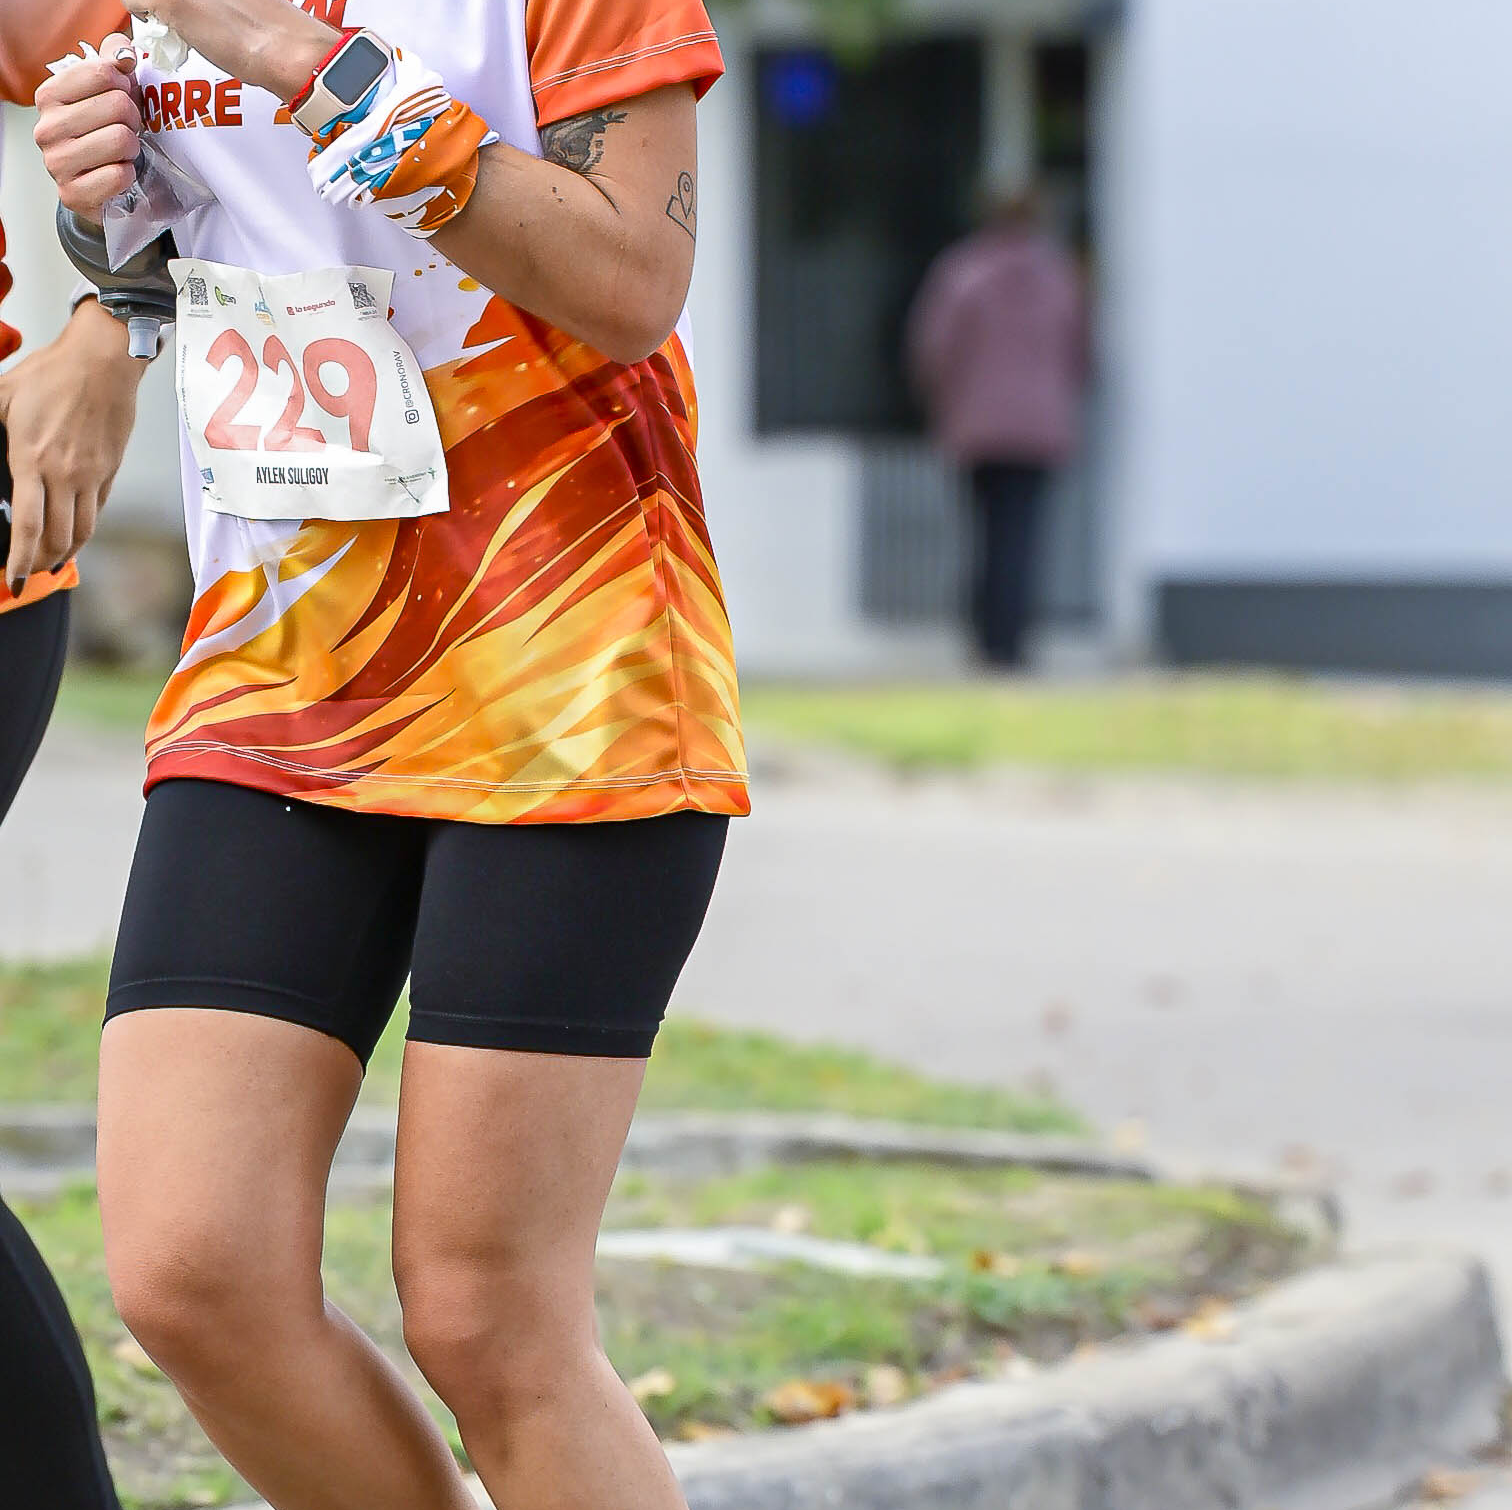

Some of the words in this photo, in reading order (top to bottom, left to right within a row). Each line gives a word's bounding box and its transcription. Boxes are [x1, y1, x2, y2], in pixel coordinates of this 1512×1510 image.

[144, 78, 244, 134] ORRE
[204, 328, 379, 454] 229
[256, 466, 286, 484] AYLEN
[287, 467, 329, 485] SULIGOY
